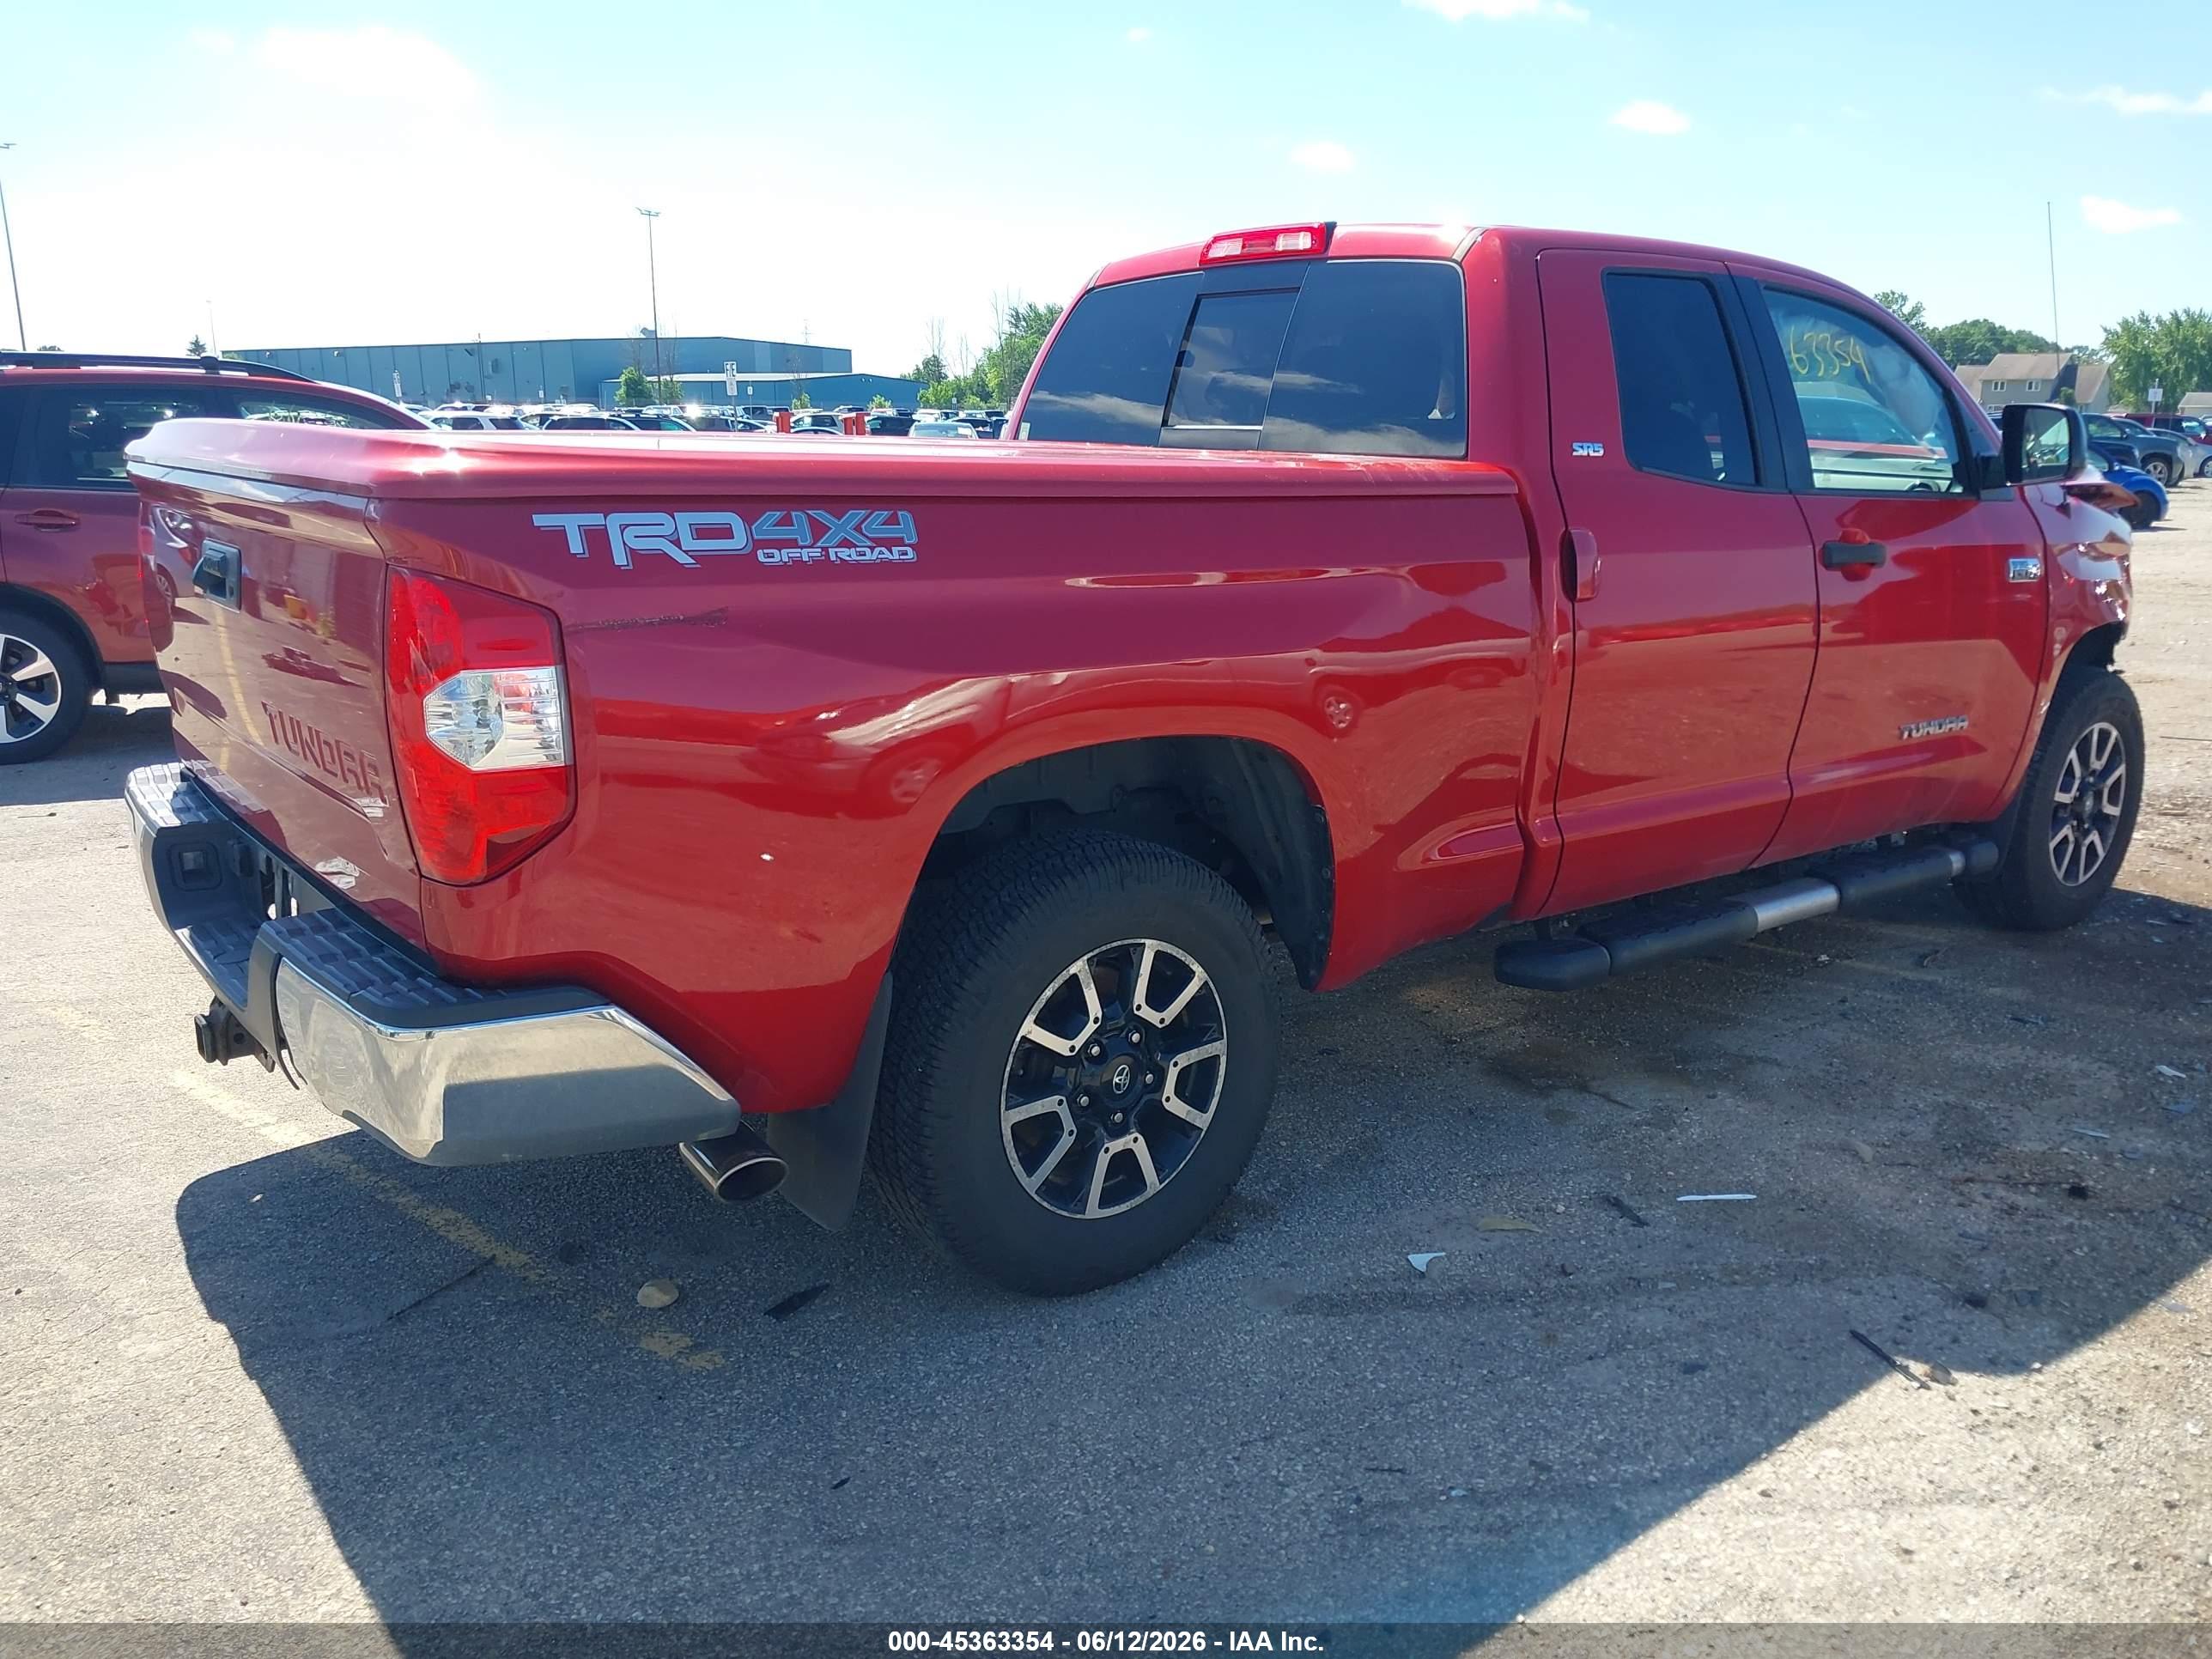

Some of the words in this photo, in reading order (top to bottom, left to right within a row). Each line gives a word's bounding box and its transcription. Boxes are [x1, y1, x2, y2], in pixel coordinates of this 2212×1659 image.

[1790, 325, 1872, 385] 63354
[1571, 441, 1604, 457] SR5
[532, 511, 753, 570] TRD
[757, 548, 825, 566] OFF
[828, 546, 918, 563] ROAD
[1899, 714, 1968, 740] TUNDRA
[261, 700, 390, 807] TUNDRA
